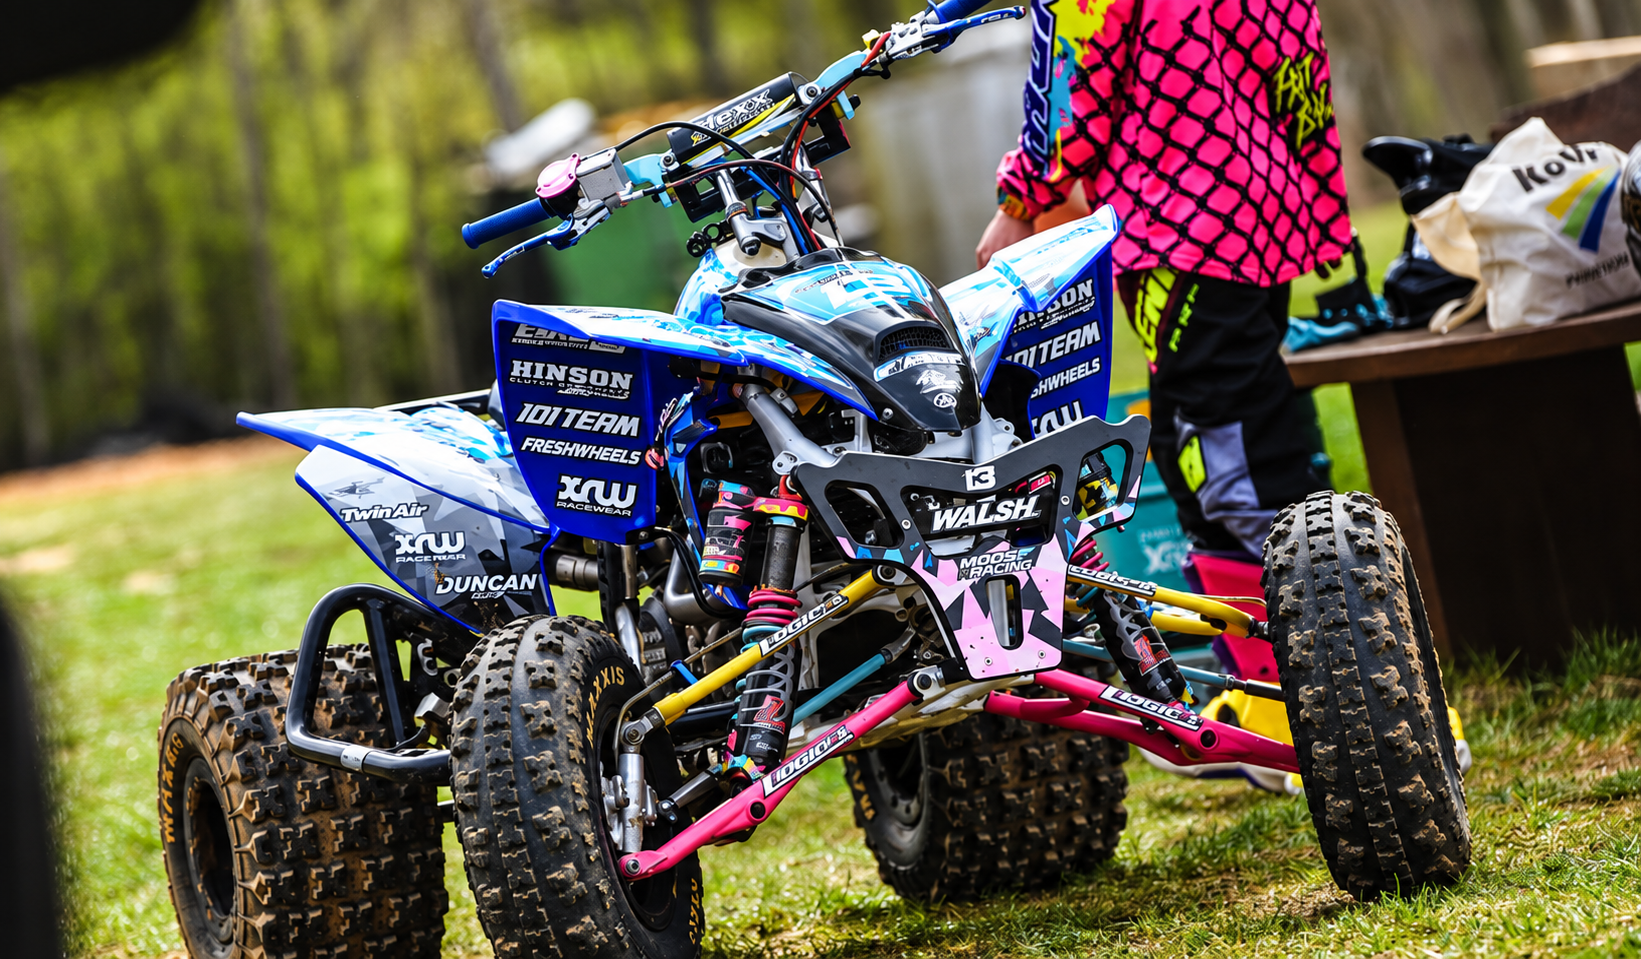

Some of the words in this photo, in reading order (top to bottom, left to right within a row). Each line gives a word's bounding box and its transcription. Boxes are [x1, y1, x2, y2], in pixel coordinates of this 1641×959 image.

[509, 377, 554, 387] CLUTCH
[510, 359, 634, 391] HINSON
[520, 437, 642, 465] FRESHWHEELS
[556, 501, 633, 517] RACEWEAR
[968, 559, 1033, 580] RACING
[435, 573, 538, 595] DUNCAN
